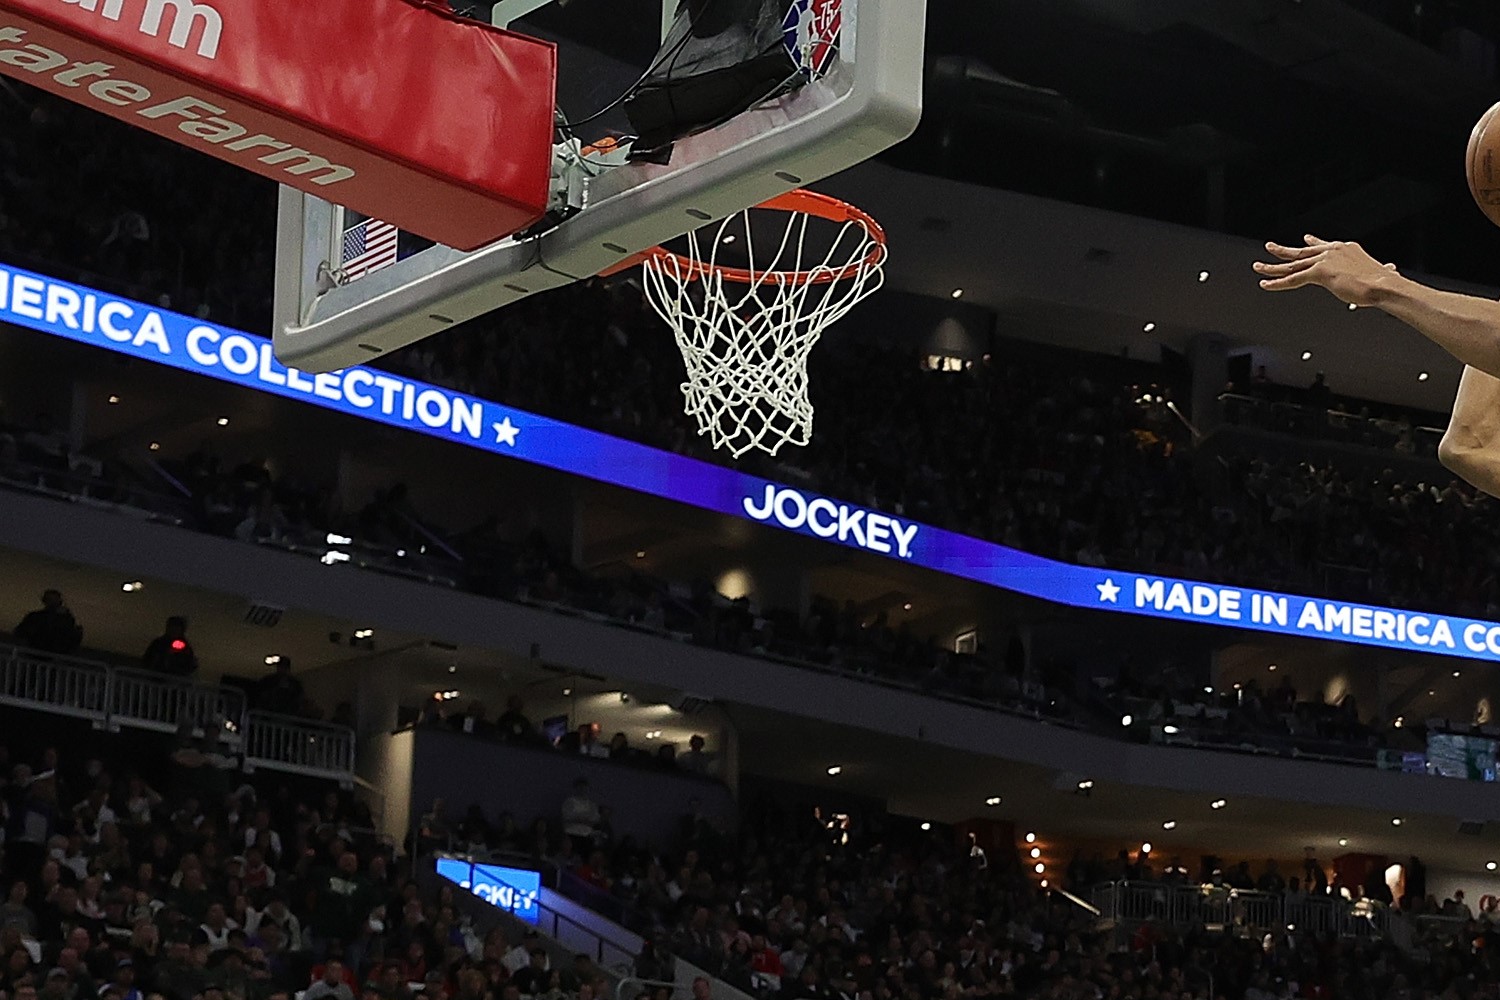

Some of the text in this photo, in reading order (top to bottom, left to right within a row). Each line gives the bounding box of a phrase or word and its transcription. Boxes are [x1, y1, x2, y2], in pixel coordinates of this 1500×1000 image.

[0, 270, 483, 438] ERICA COLLECTION
[743, 484, 918, 558] JOCKEY
[1135, 578, 1241, 620] MADE
[1252, 593, 1288, 625] IN
[1297, 601, 1456, 648] AMERICA
